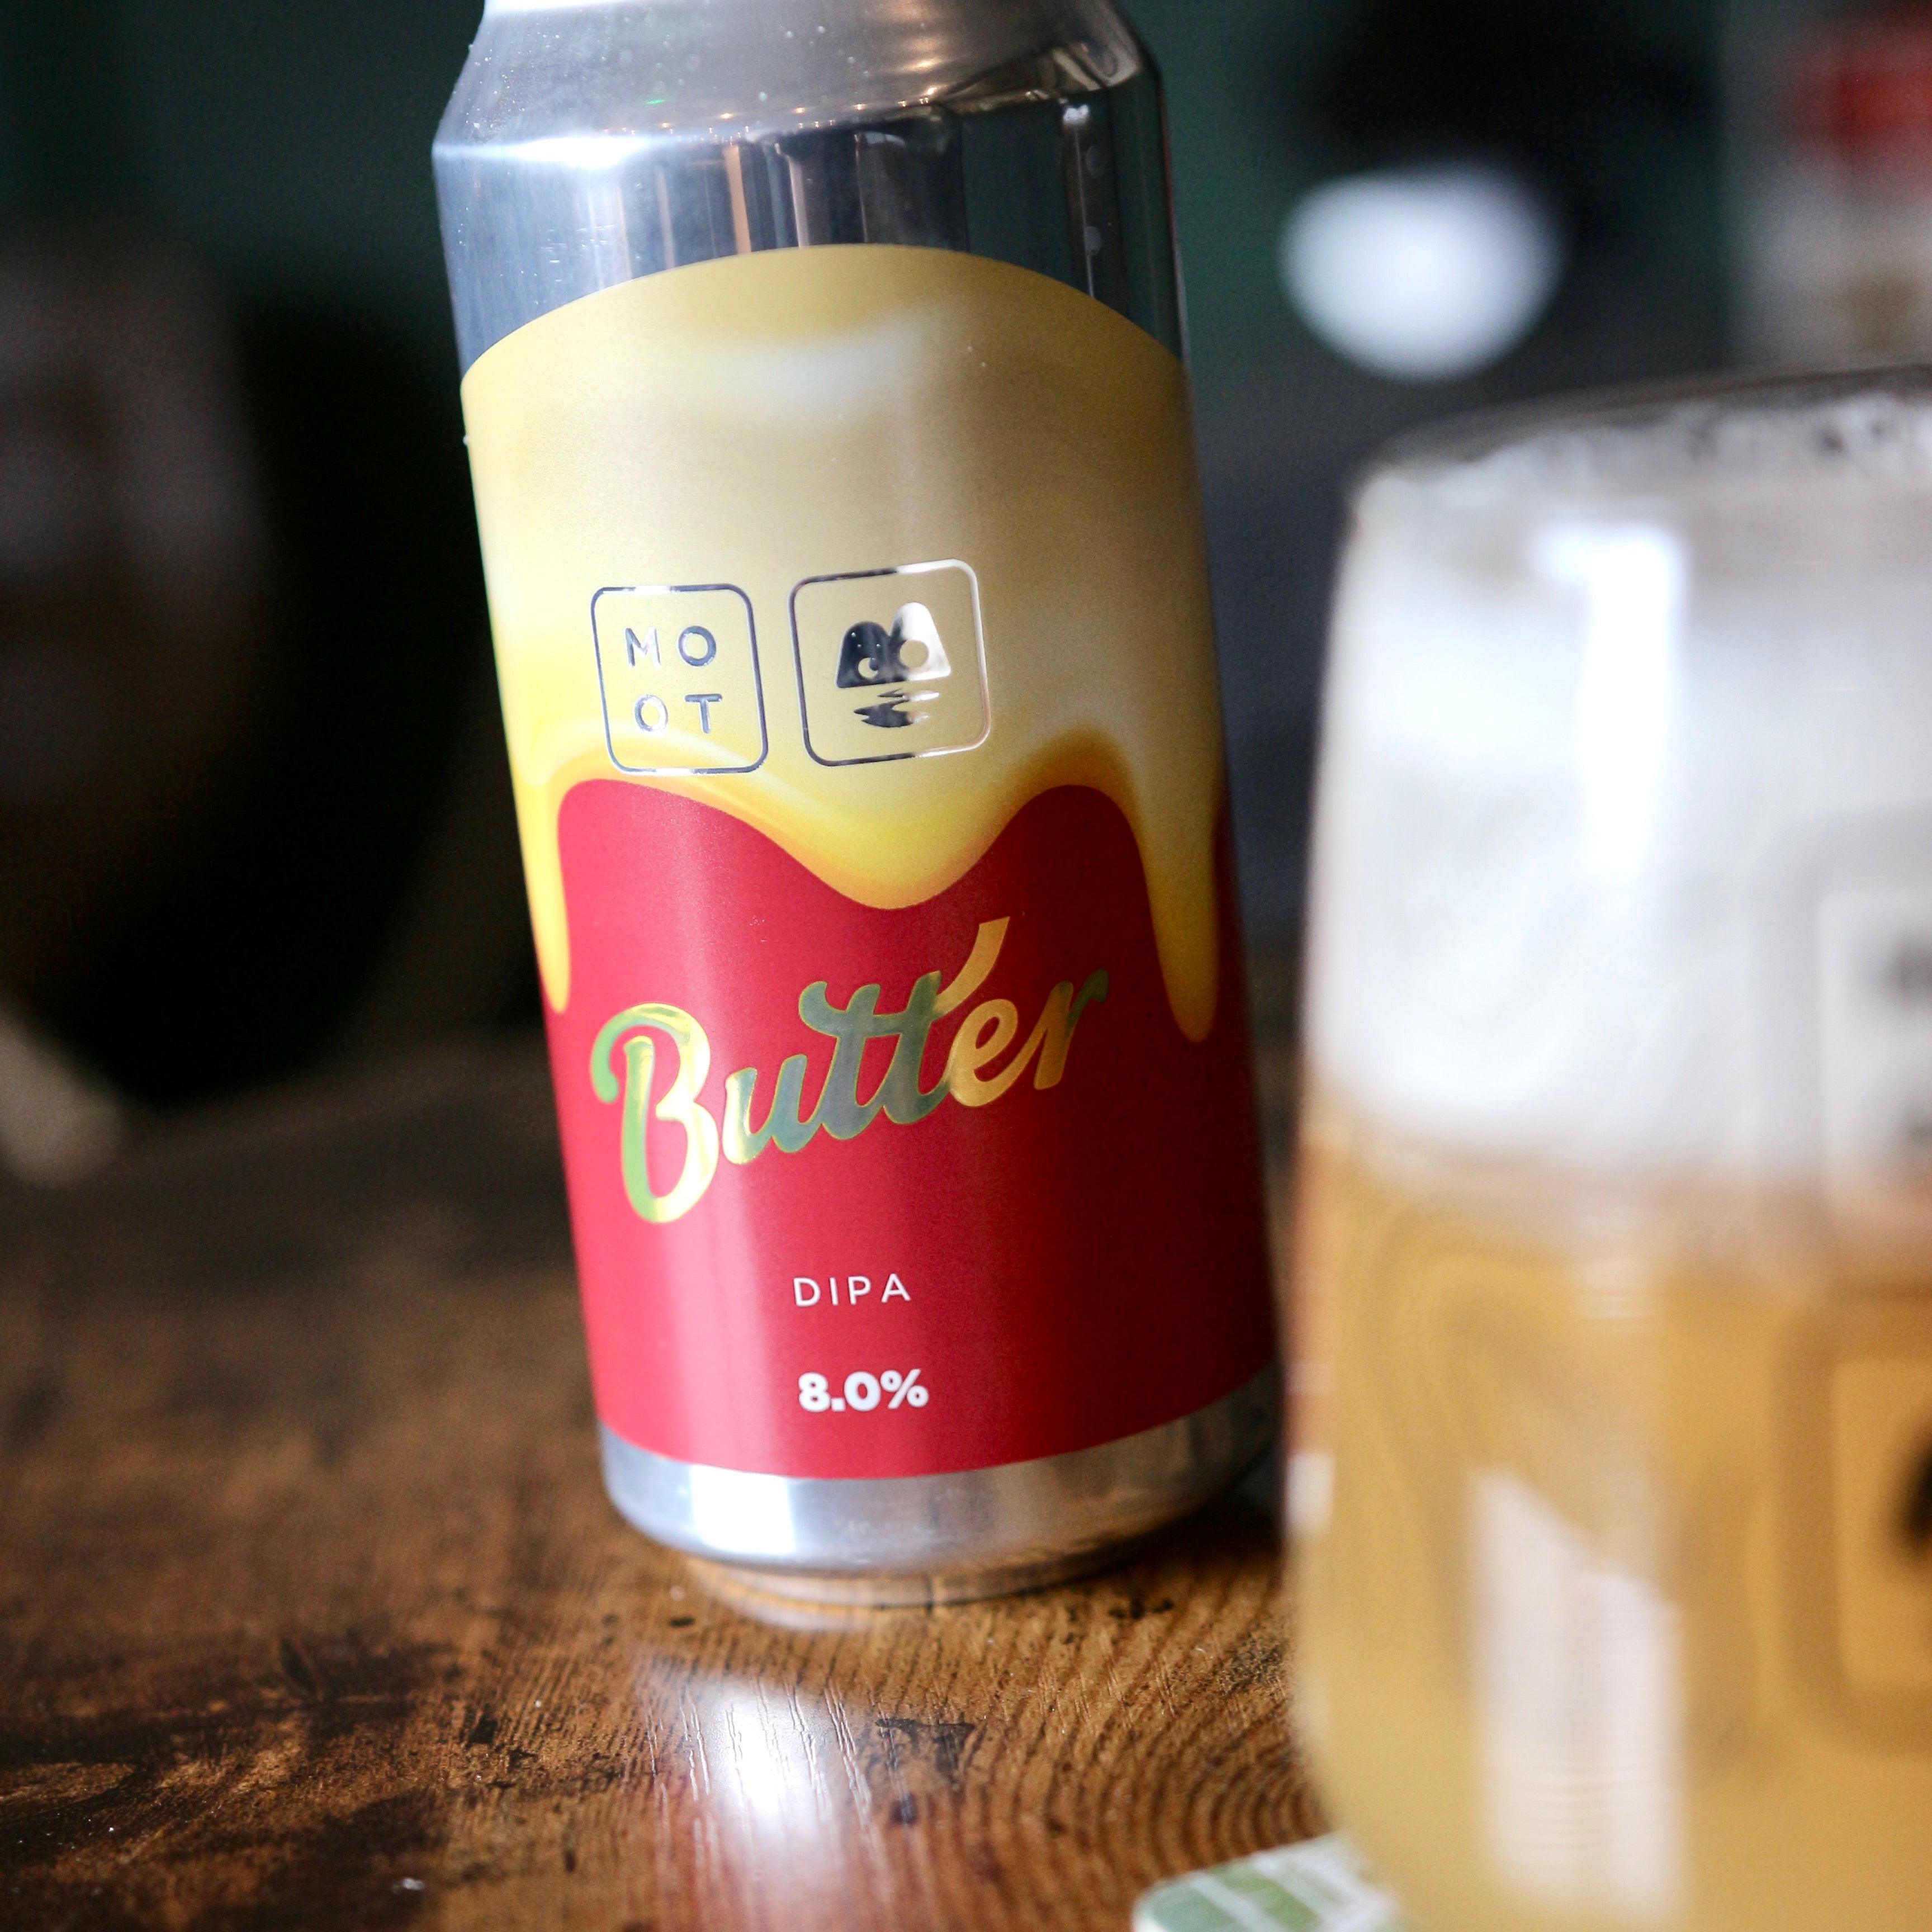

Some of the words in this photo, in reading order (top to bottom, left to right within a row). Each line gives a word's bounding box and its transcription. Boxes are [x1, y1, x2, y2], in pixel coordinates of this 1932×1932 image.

[590, 916, 1109, 1223] Butter
[793, 1273, 911, 1307] DIPA
[798, 1368, 929, 1413] 8.0%
